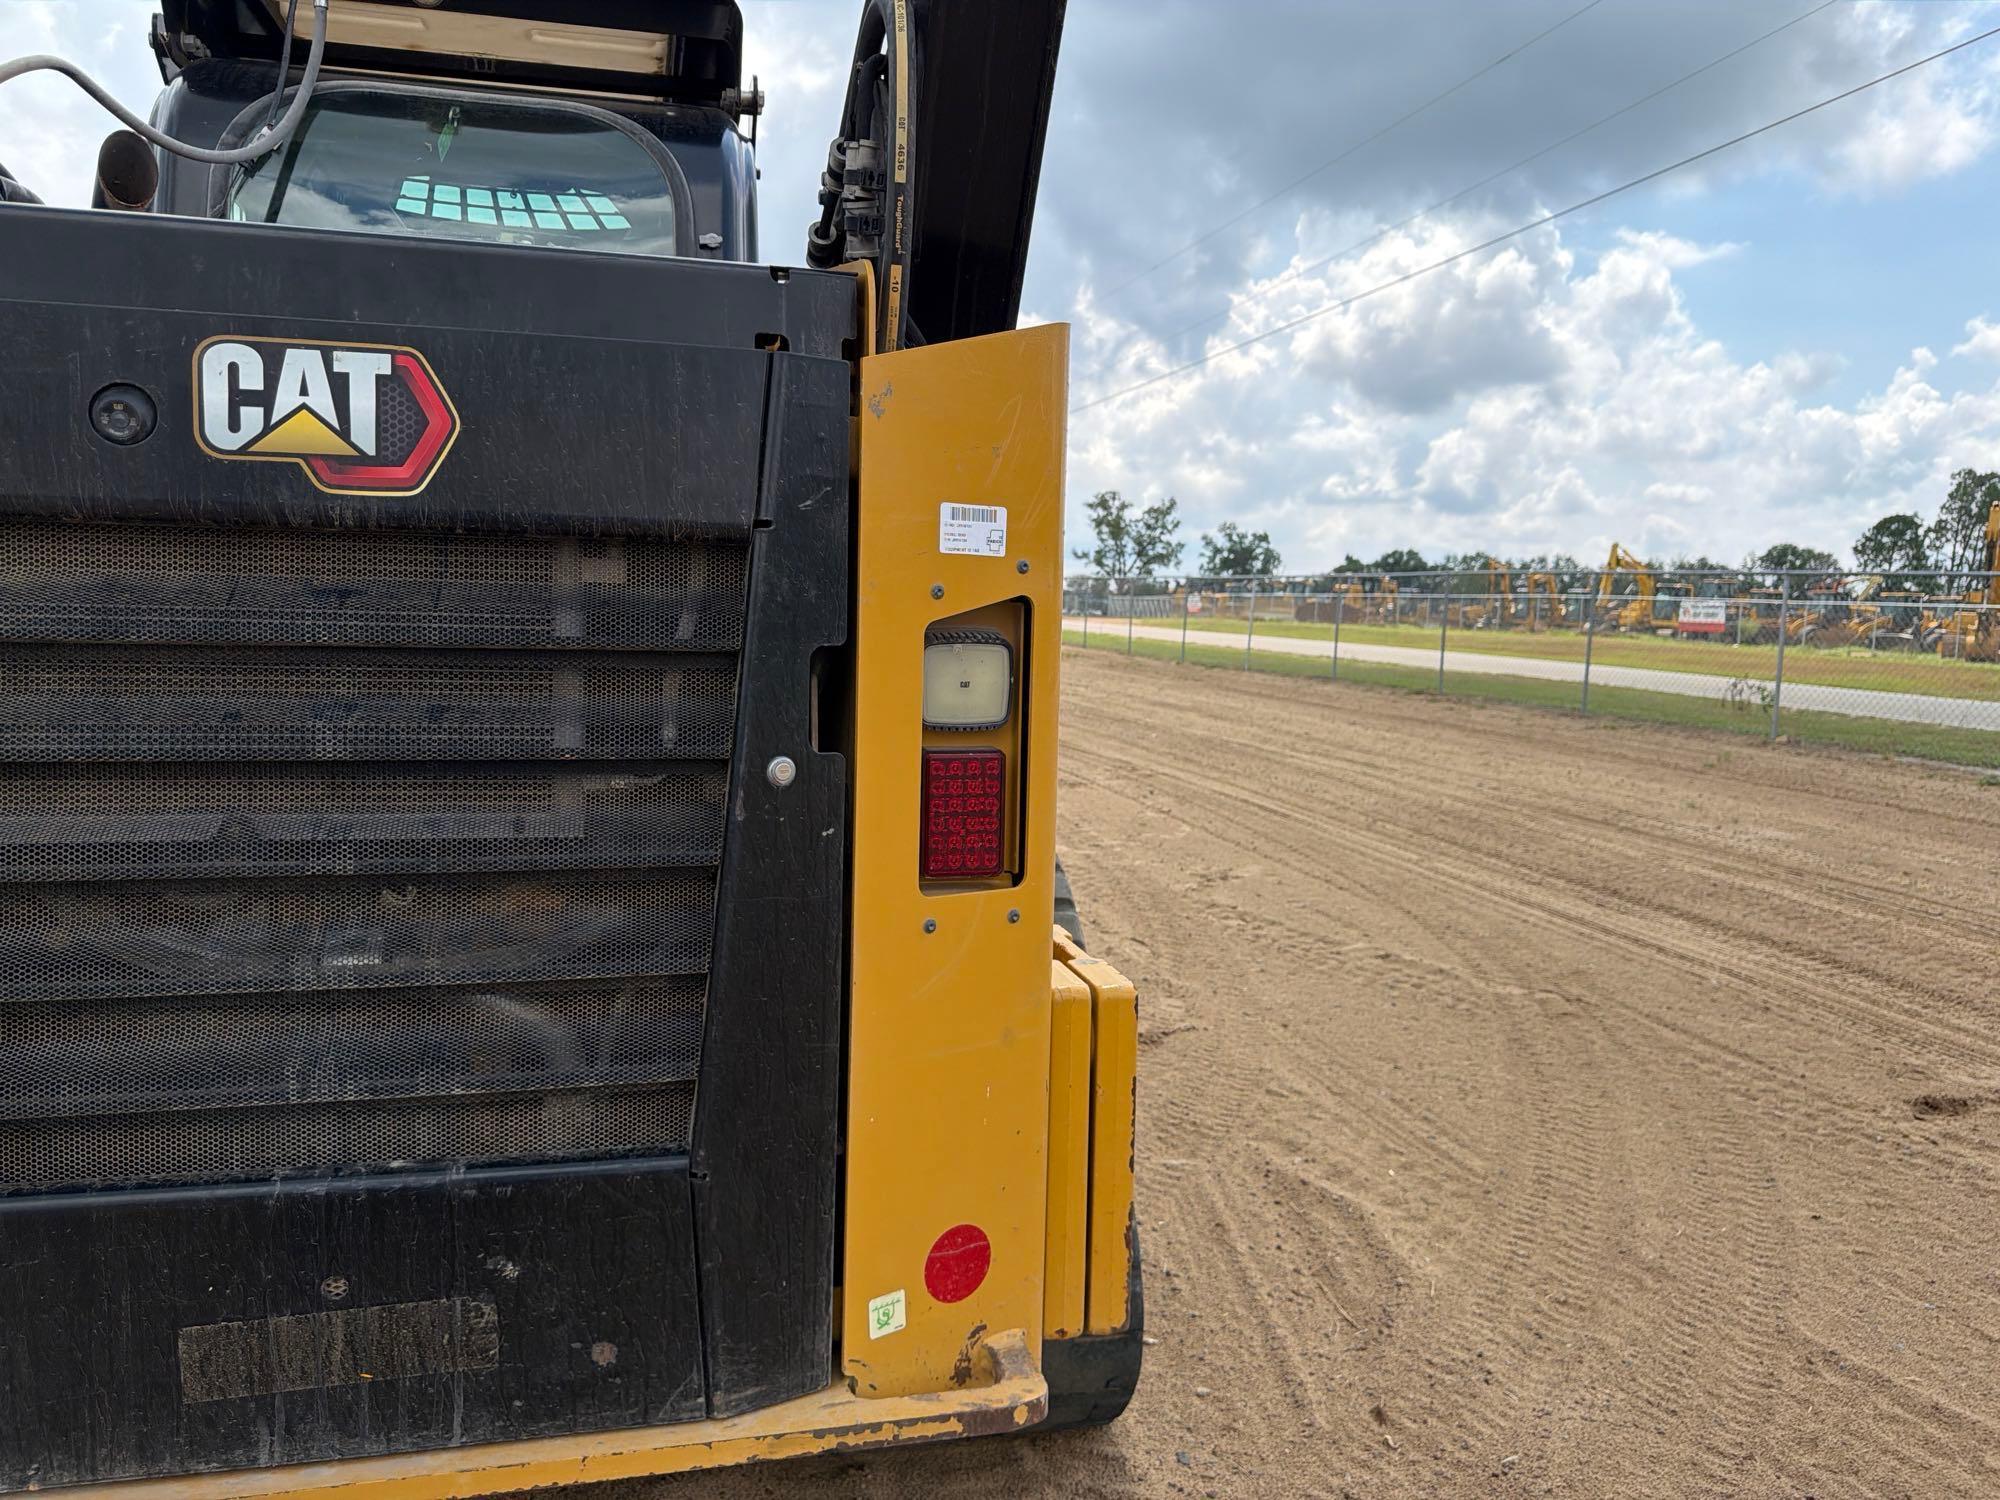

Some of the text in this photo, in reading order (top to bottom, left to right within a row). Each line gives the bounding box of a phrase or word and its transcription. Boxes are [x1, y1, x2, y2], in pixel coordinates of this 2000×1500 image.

[897, 117, 906, 171] CAT 4636
[895, 195, 904, 248] ToughGuard
[891, 276, 900, 293] -10
[202, 342, 392, 456] CAT
[960, 680, 970, 689] CAT
